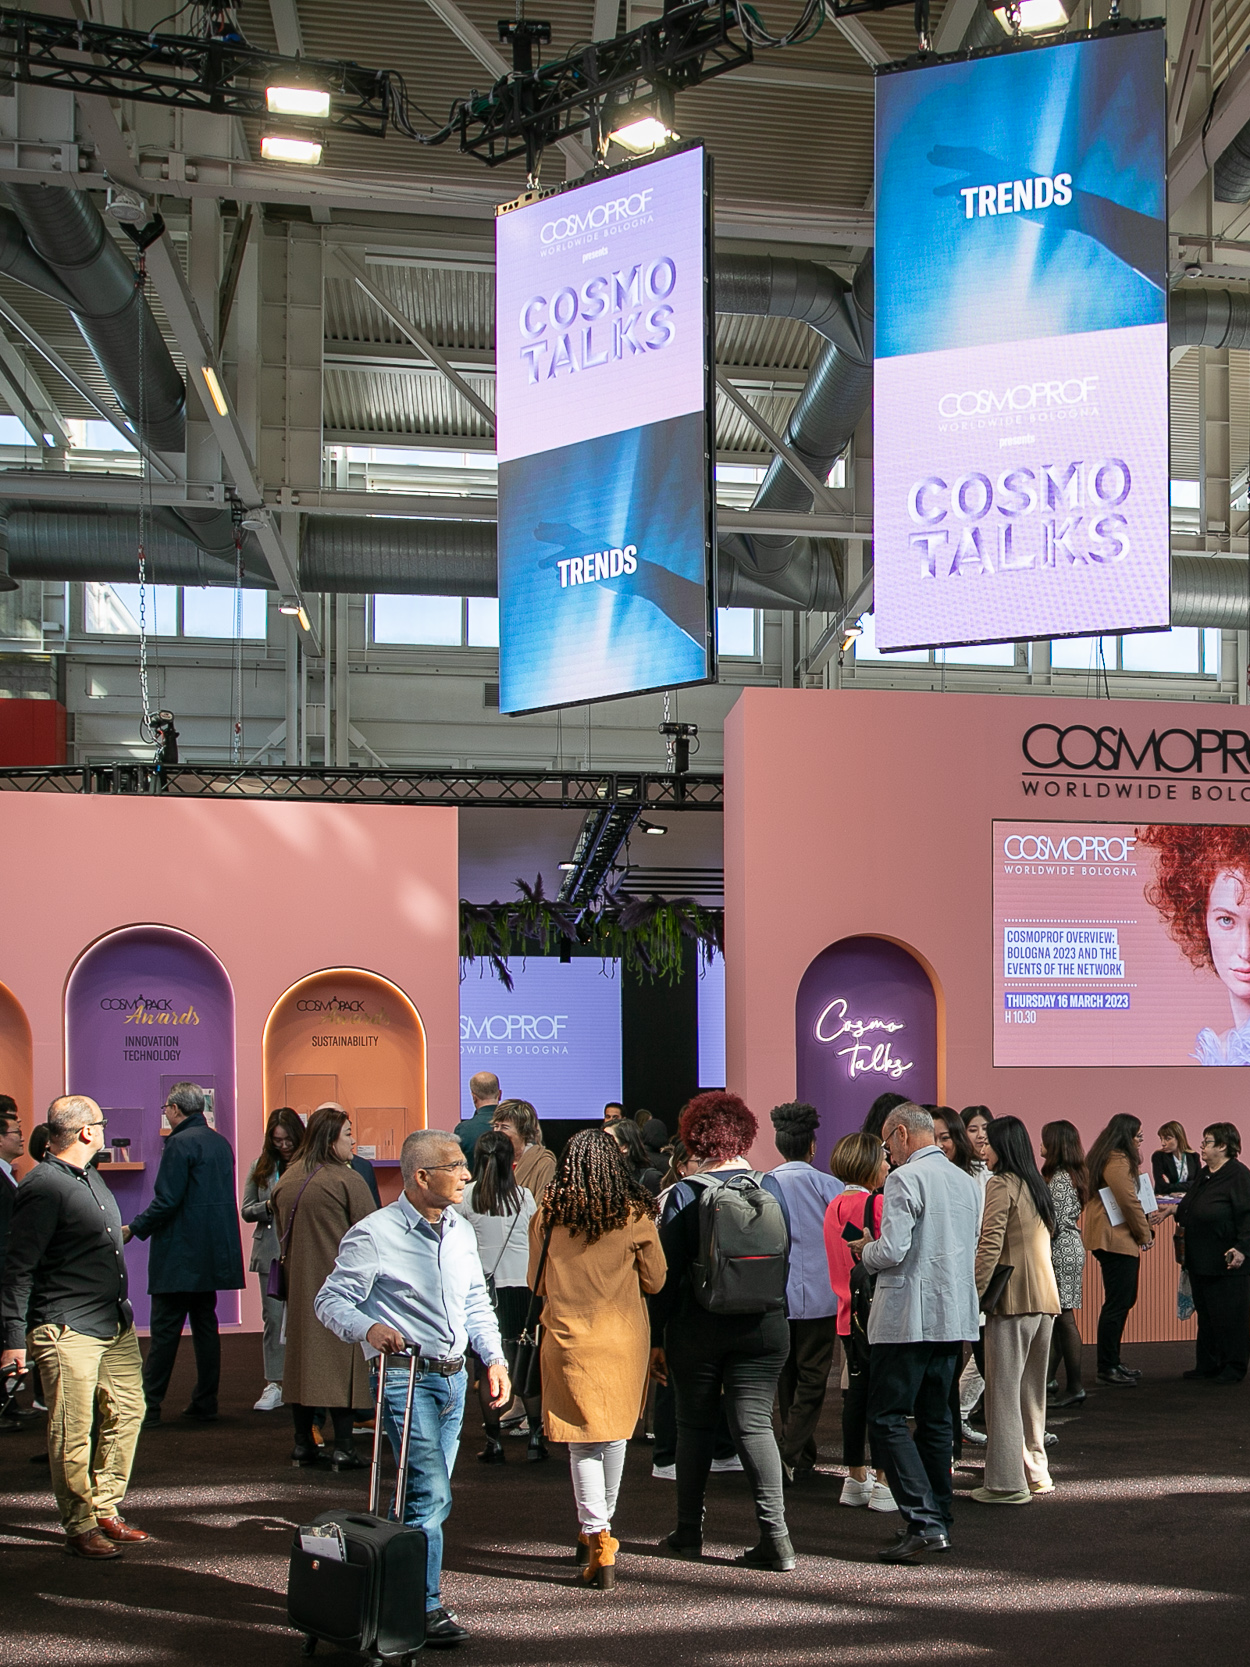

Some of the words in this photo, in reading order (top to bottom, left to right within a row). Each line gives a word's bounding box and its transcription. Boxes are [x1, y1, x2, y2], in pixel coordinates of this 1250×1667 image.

[960, 172, 1073, 219] TRENDS
[540, 188, 654, 244] COSMOPROF
[540, 232, 599, 258] WORLDWIDE
[603, 215, 654, 238] BOLOGNA
[582, 246, 609, 264] presents
[519, 256, 677, 339] COSMO
[520, 304, 676, 385] TALKS
[938, 376, 1099, 418] COSMOPROF
[938, 416, 1025, 433] WORLDWIDE
[1030, 407, 1099, 423] BOLOGNA
[999, 434, 1036, 448] presents
[907, 457, 1132, 526] COSMO
[909, 513, 1130, 580] TALKS
[557, 544, 638, 588] TRENDS
[1022, 780, 1177, 800] WORLDWIDE
[1004, 835, 1137, 861] COSMOPROF
[1004, 865, 1075, 876] WORLDWIDE
[1081, 866, 1137, 876] BOLOGNA
[1007, 930, 1064, 943] COSMOPROF
[1066, 931, 1115, 944] OVERVIEW:
[1007, 946, 1051, 959] BOLOGNA
[1053, 947, 1076, 959] 2023
[1078, 947, 1098, 959] AND
[1100, 947, 1117, 960] THE
[1007, 962, 1042, 975] EVENTS
[1044, 963, 1056, 975] OF
[1057, 963, 1075, 975] THE
[1077, 963, 1122, 975] NETWORK
[100, 997, 173, 1010] COSMOPACK
[296, 999, 365, 1011] COSMOPACK
[1006, 994, 1056, 1008] THURSDAY
[1057, 994, 1068, 1008] 16
[1069, 994, 1104, 1008] MARCH
[1105, 994, 1129, 1008] 2023
[123, 1005, 200, 1025] Awards
[816, 998, 904, 1042] Cosmo
[1005, 1010, 1012, 1024] H
[1013, 1010, 1037, 1024] 10.30
[460, 1014, 568, 1039] SMOPROF
[125, 1035, 179, 1047] INNOVATION
[311, 1035, 379, 1047] SUSTAINABILITY
[460, 1045, 499, 1055] DWIDE
[507, 1045, 569, 1055] BOLOGNA
[123, 1050, 181, 1061] TECHNOLOGY
[837, 1043, 914, 1078] Talks
